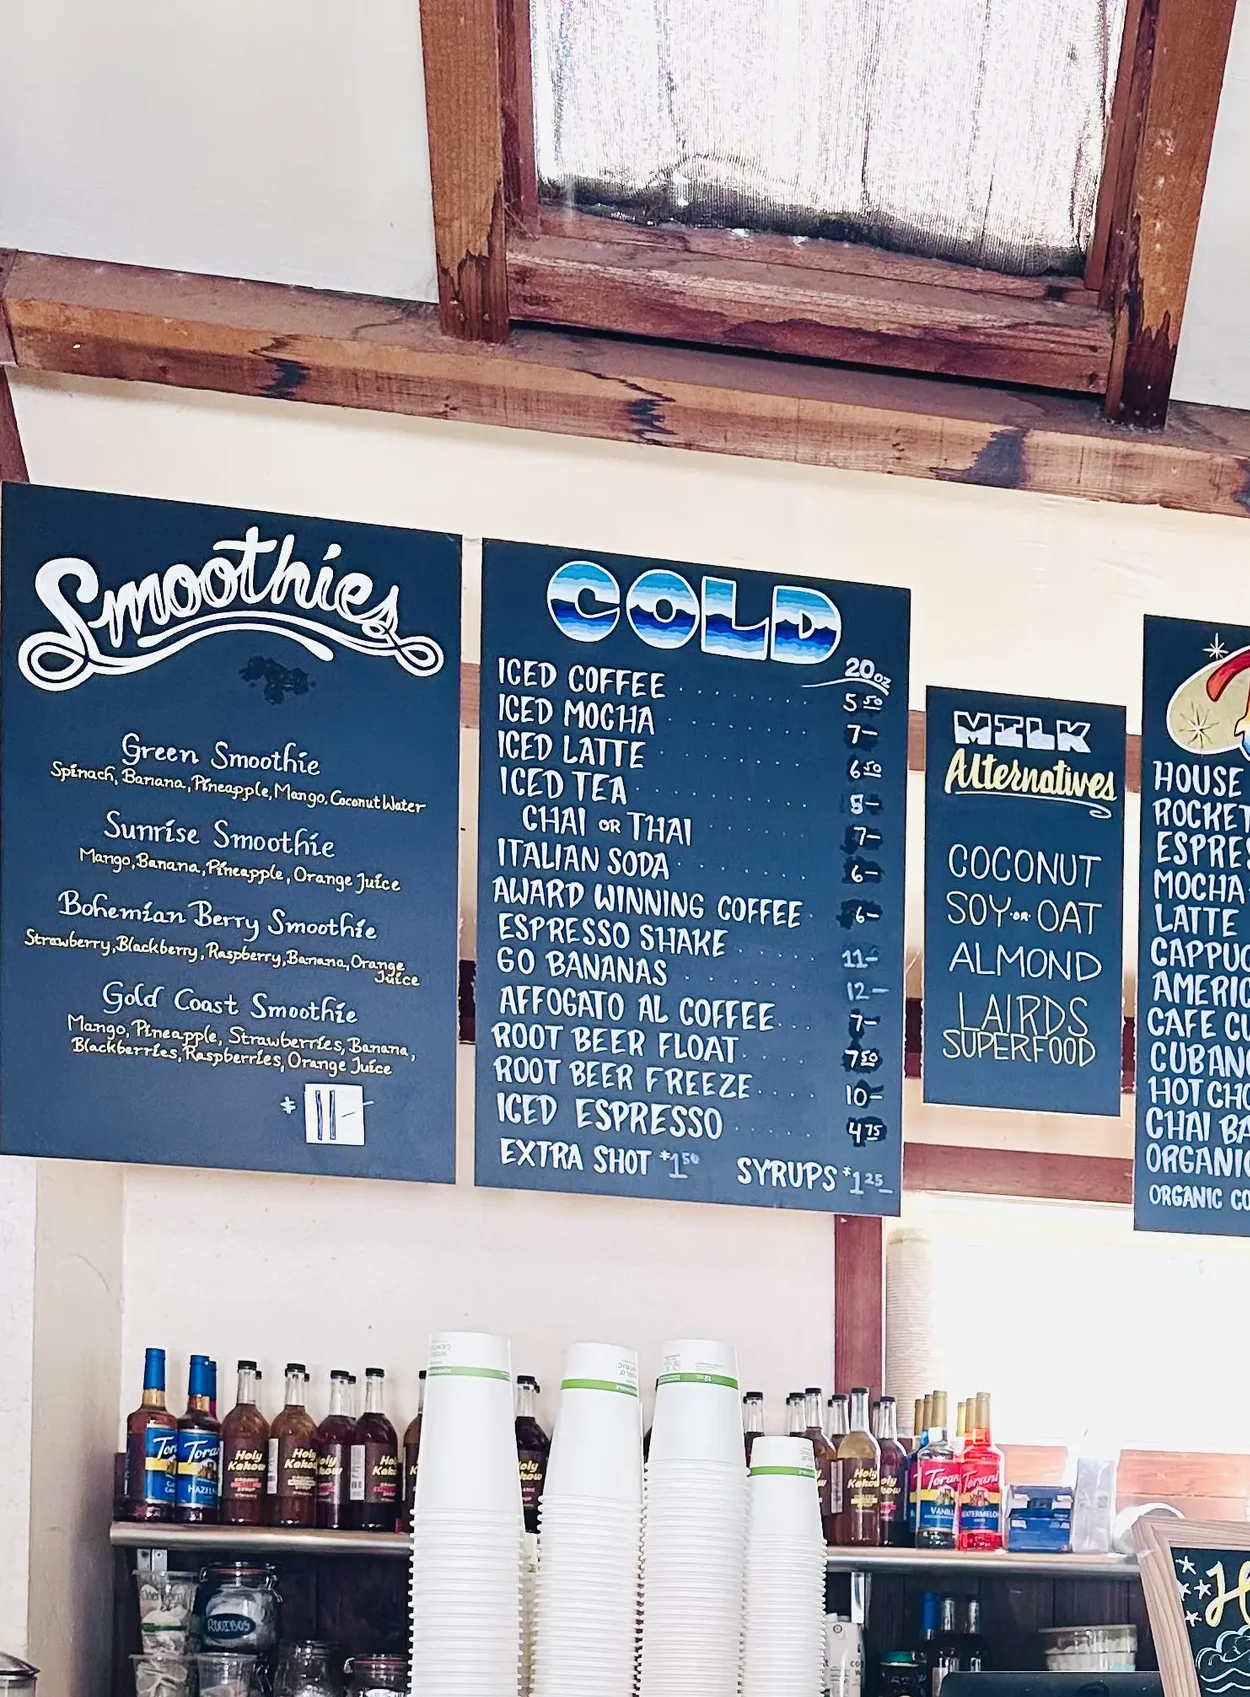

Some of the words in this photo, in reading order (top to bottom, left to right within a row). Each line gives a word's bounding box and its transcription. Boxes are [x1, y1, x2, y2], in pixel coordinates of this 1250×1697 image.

[18, 526, 444, 691] Smoothies
[547, 560, 841, 665] COLD
[497, 657, 557, 687] ICED
[568, 665, 665, 699] COFFEE
[498, 694, 553, 725] ICED
[564, 700, 655, 735] MOCHA
[953, 710, 1091, 754] MILK
[122, 732, 199, 764] Green
[211, 741, 320, 776] Smoothie
[497, 730, 553, 760] ICED
[563, 737, 646, 769] LATTE
[51, 762, 118, 786] Spinach,
[122, 769, 190, 792] Banana,
[192, 774, 273, 802] Pineapple,
[331, 791, 382, 810] Coconut
[383, 795, 426, 814] Water
[944, 748, 1117, 801] Alternatives
[1153, 761, 1244, 798] HOUSE
[104, 810, 200, 846] Sunrise
[213, 819, 335, 858] Smoothie
[497, 838, 600, 872] ITALIAN
[607, 847, 670, 880] SODA
[948, 844, 1101, 888] COCONUT
[492, 876, 584, 909] AWARD
[594, 887, 704, 919] WINNING
[717, 896, 803, 929] COFFEE
[1153, 870, 1245, 904] MOCHA
[58, 890, 186, 925] Bohemian
[188, 900, 259, 942] Berry
[268, 909, 377, 941] Smoothie
[946, 891, 1012, 928] SOY
[1037, 900, 1102, 935] OAT
[1154, 903, 1239, 936] LATTE
[499, 913, 630, 949] ESPRESSO
[639, 926, 728, 957] SHAKE
[949, 941, 1101, 981] ALMOND
[102, 982, 164, 1014] Gold
[175, 989, 239, 1016] Coast
[250, 993, 358, 1024] Smoothie
[499, 987, 625, 1022] AFFOGATO
[638, 995, 669, 1023] AL
[679, 998, 776, 1032] COFFEE
[959, 992, 1089, 1038] LAIRDS
[1148, 1007, 1217, 1038] CAFE
[491, 1022, 564, 1052] ROOT
[571, 1027, 646, 1057] BEER
[659, 1032, 739, 1064] FLOAT
[943, 1030, 1096, 1067] SUPERFOOD
[1148, 1077, 1204, 1105] HOT
[1146, 1108, 1211, 1142] CHAI
[736, 1156, 838, 1192] SYRUPS
[235, 1449, 263, 1462] Holy
[962, 1470, 1000, 1491] Torani
[207, 1618, 251, 1633] ROOIBOS
